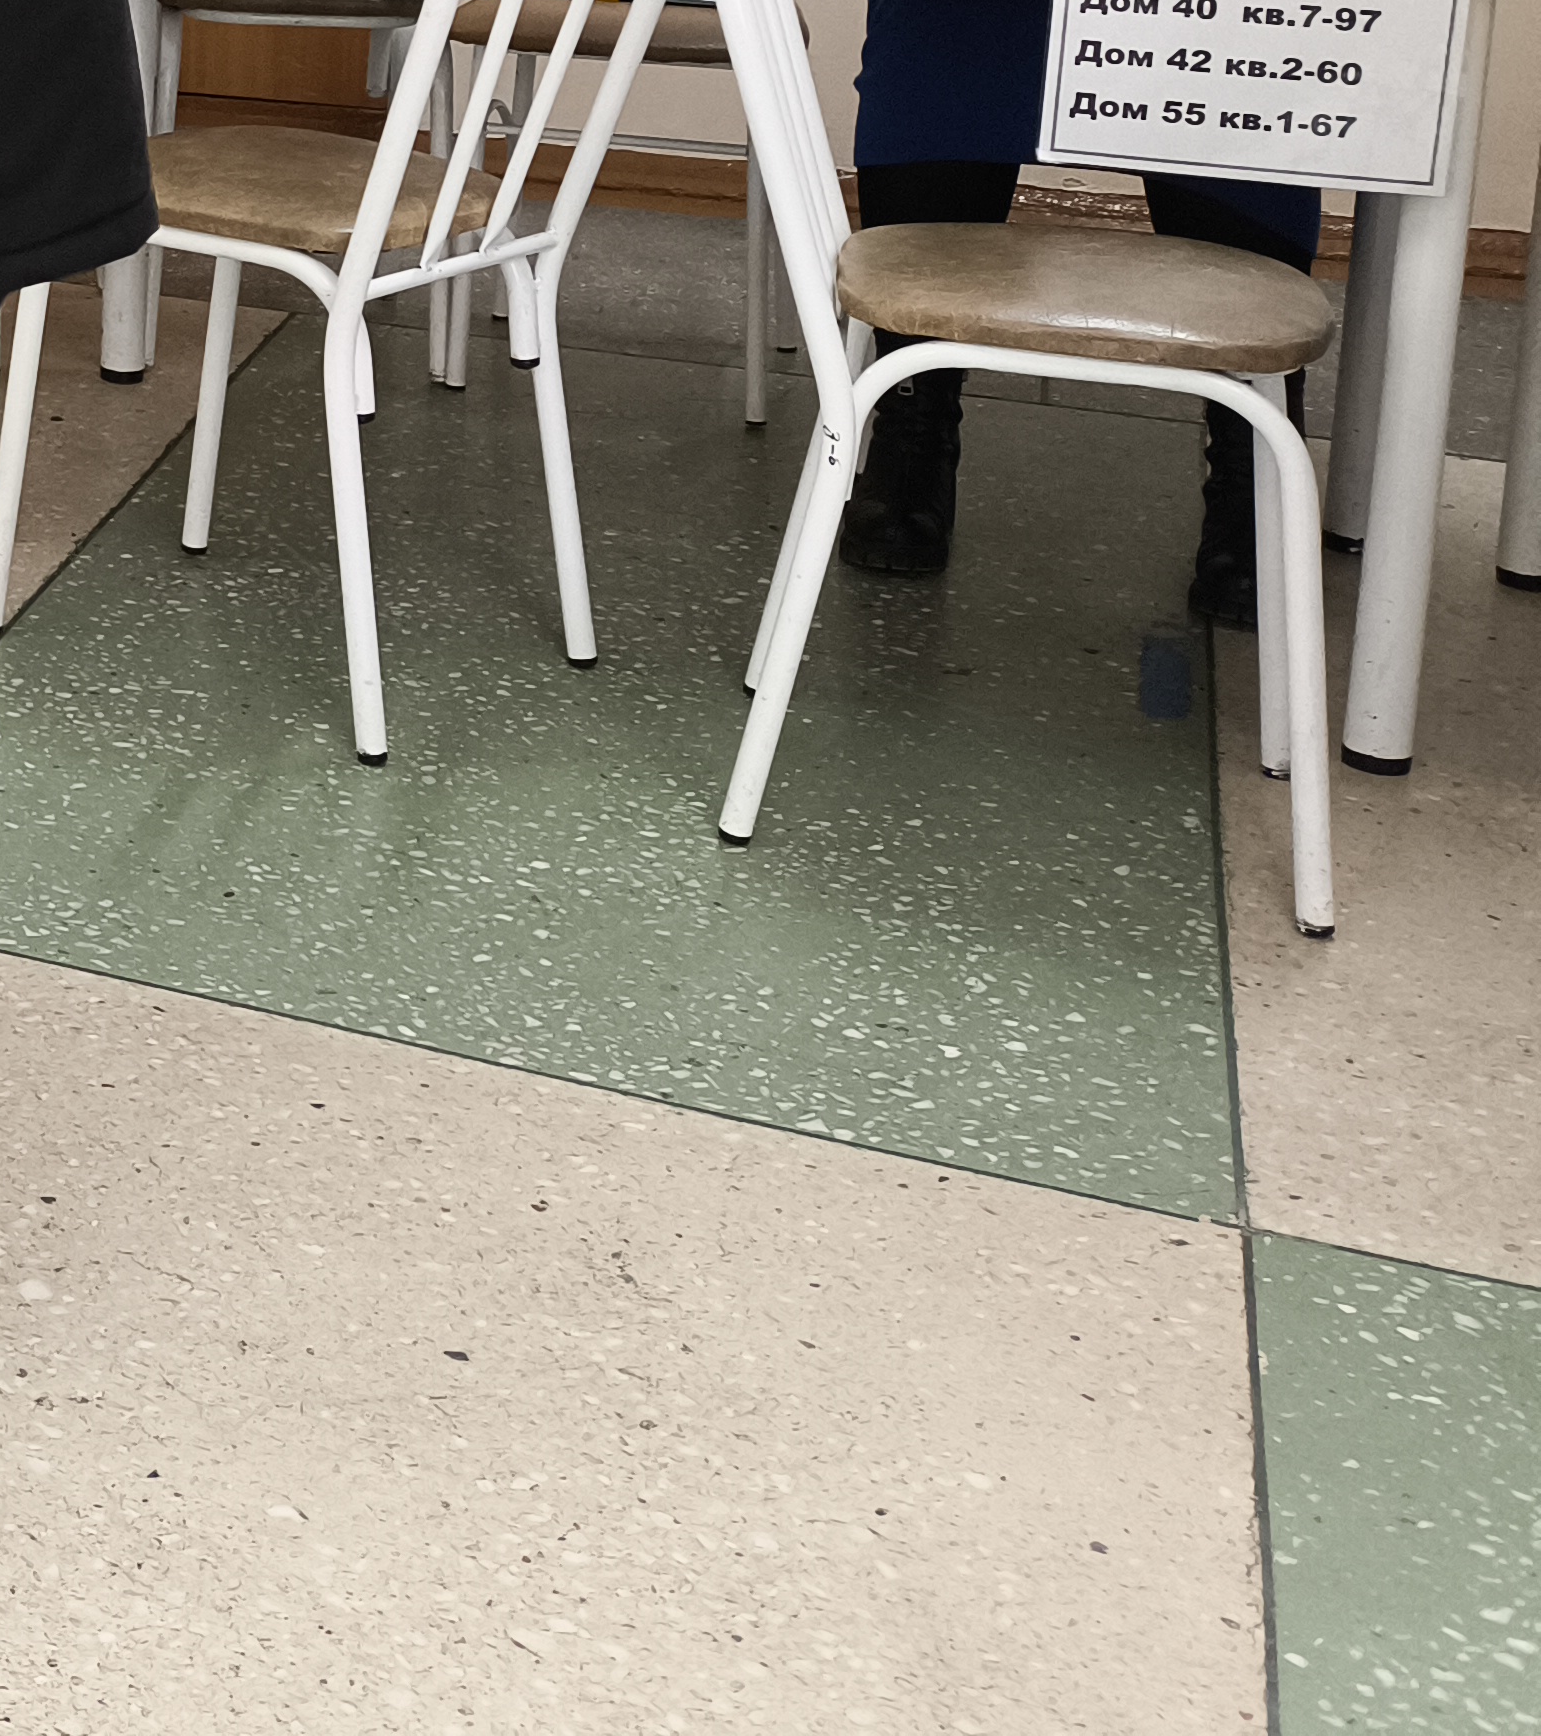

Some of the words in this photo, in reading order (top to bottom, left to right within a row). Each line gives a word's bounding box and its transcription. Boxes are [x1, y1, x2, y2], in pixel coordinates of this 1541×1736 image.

[1242, 4, 1383, 34] кв.7-97
[1074, 39, 1154, 69] Дом
[1167, 47, 1212, 74] 42
[1225, 56, 1363, 86] кв.2-60
[1069, 91, 1149, 121] Дом
[1161, 100, 1206, 126] 55
[1219, 110, 1358, 139] кв.1-67
